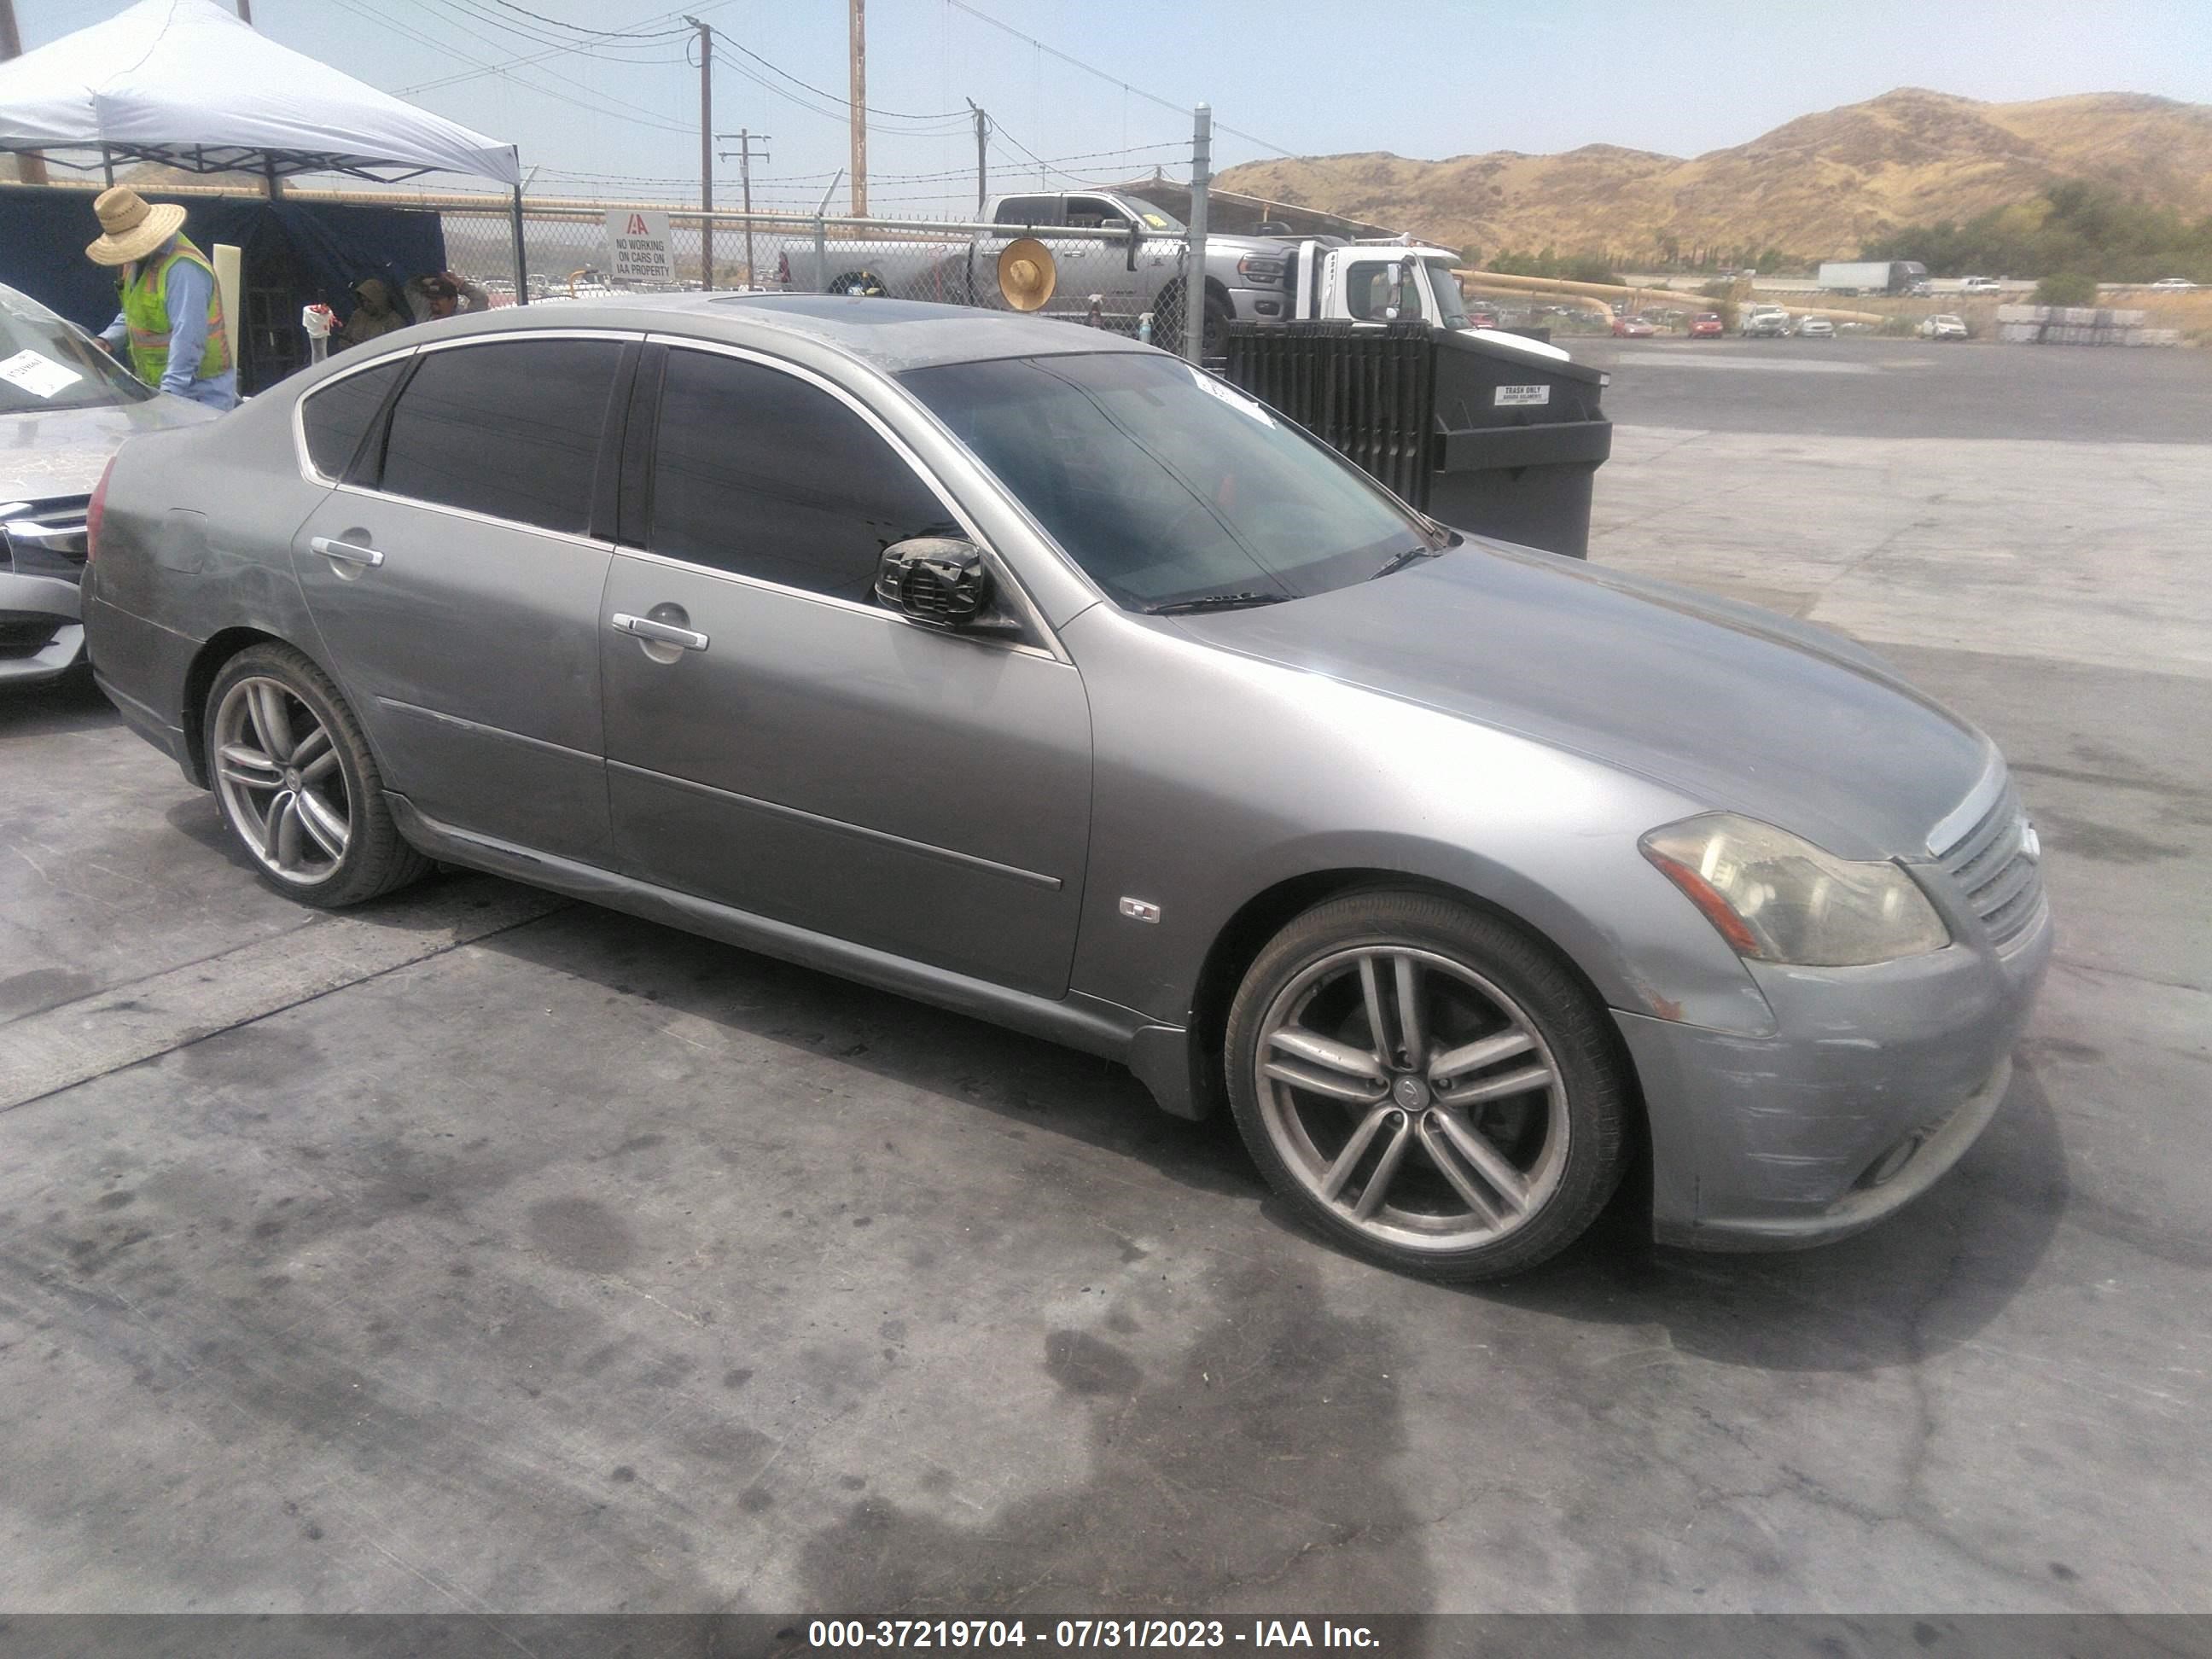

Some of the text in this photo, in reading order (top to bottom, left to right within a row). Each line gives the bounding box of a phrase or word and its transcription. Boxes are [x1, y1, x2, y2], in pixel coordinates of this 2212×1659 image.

[616, 239, 664, 251] NO WORKING
[619, 251, 665, 264] ON CARS ON
[617, 264, 670, 276] IAA PROPERTY
